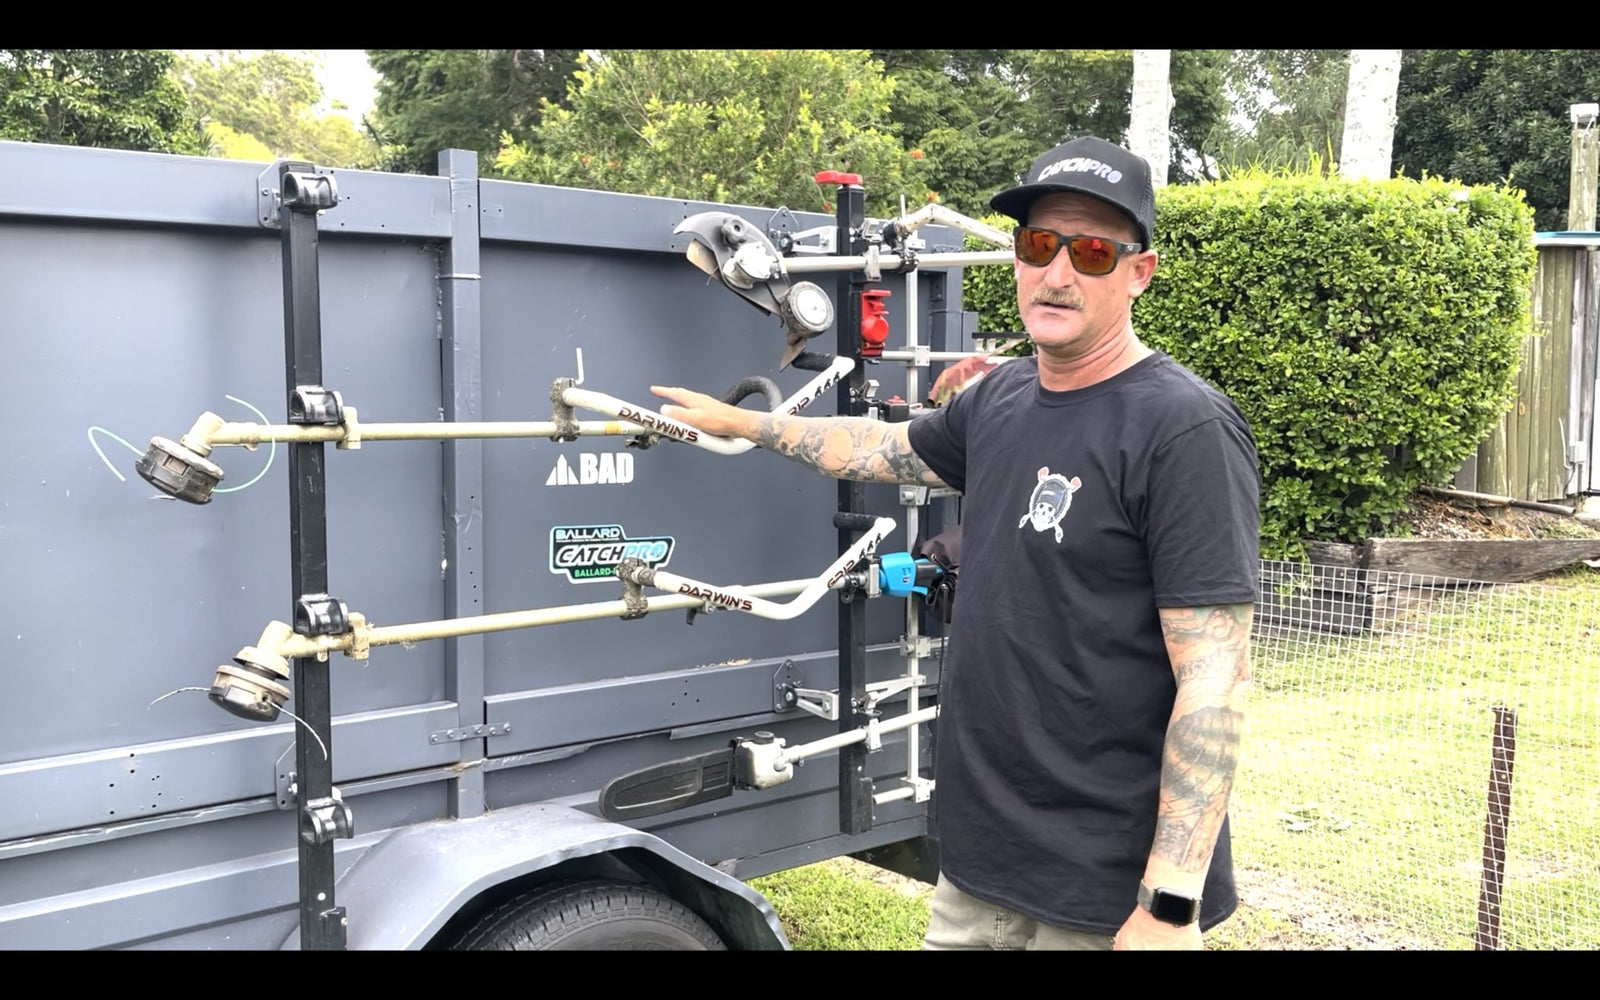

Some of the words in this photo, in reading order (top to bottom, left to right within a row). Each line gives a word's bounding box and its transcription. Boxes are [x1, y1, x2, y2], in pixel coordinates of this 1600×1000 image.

[1037, 157, 1123, 184] CATCHPRO
[618, 406, 699, 442] DARWIN'S
[787, 396, 810, 416] RIP
[579, 452, 634, 485] BAD
[555, 527, 621, 540] BALLARD
[557, 541, 668, 566] CATCHPRO
[678, 583, 752, 611] DARWIN'S
